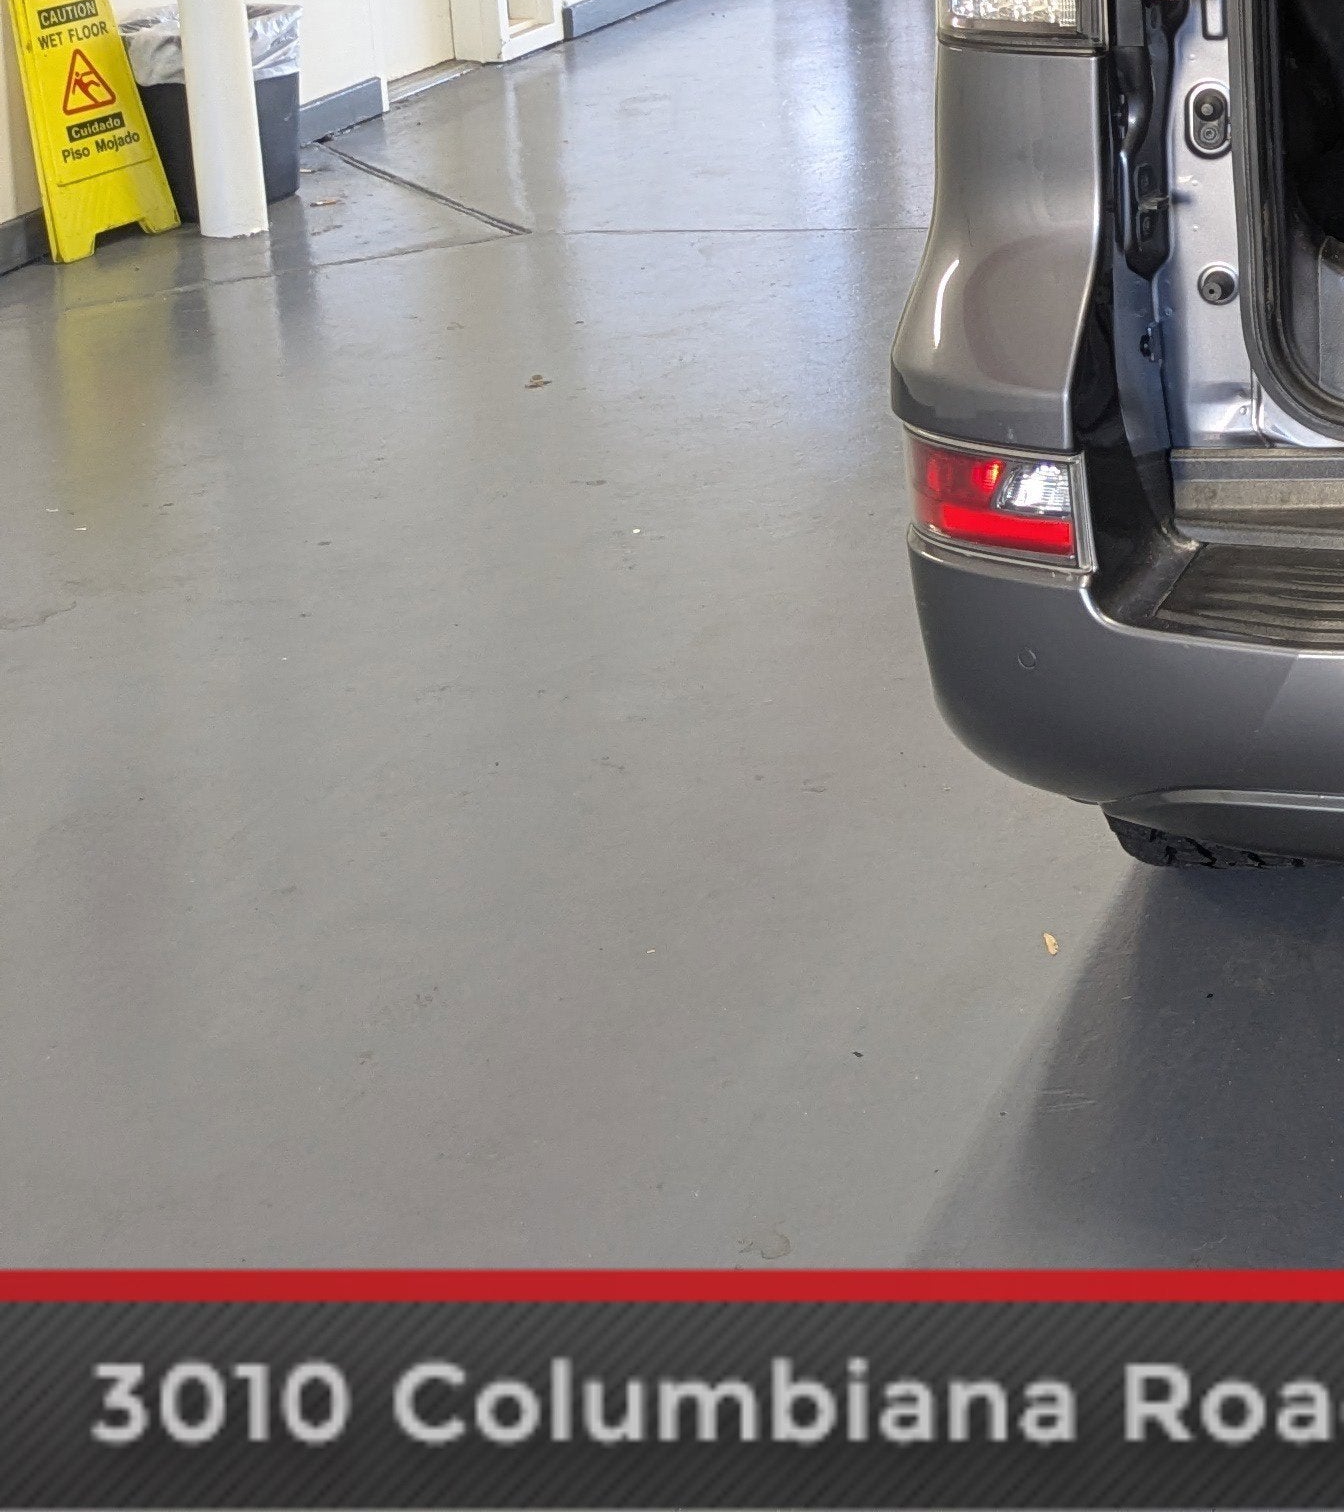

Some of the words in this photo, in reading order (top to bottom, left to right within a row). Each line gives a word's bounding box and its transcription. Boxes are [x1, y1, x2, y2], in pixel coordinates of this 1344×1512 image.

[40, 0, 97, 27] CAUTION
[37, 32, 63, 51] WET
[68, 21, 109, 44] FLOOR
[71, 115, 122, 139] Cuidado
[61, 147, 91, 164] Piso
[94, 130, 141, 154] Mojado
